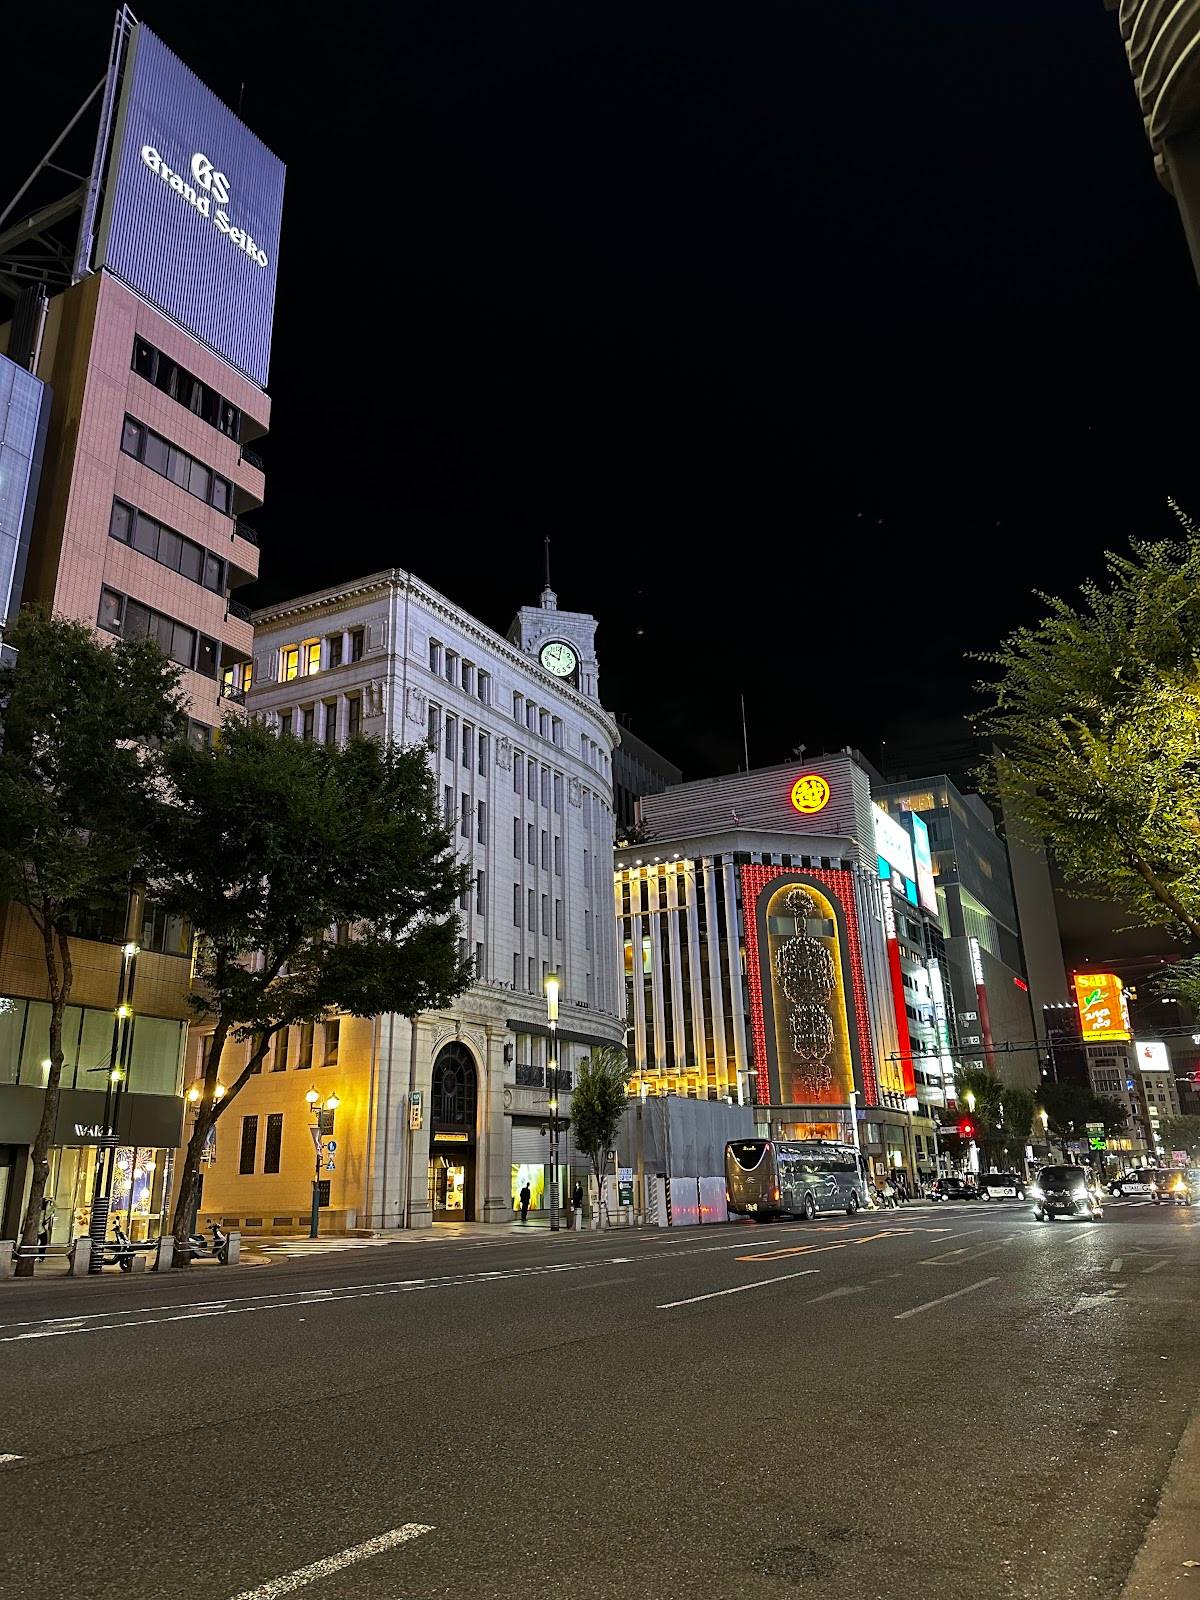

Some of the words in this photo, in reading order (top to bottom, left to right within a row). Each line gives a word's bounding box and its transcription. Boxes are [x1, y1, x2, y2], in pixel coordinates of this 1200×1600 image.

[141, 145, 211, 218] Grand
[213, 209, 268, 268] Seiko
[191, 152, 231, 204] GS
[881, 880, 897, 939] MITSUKOSHI
